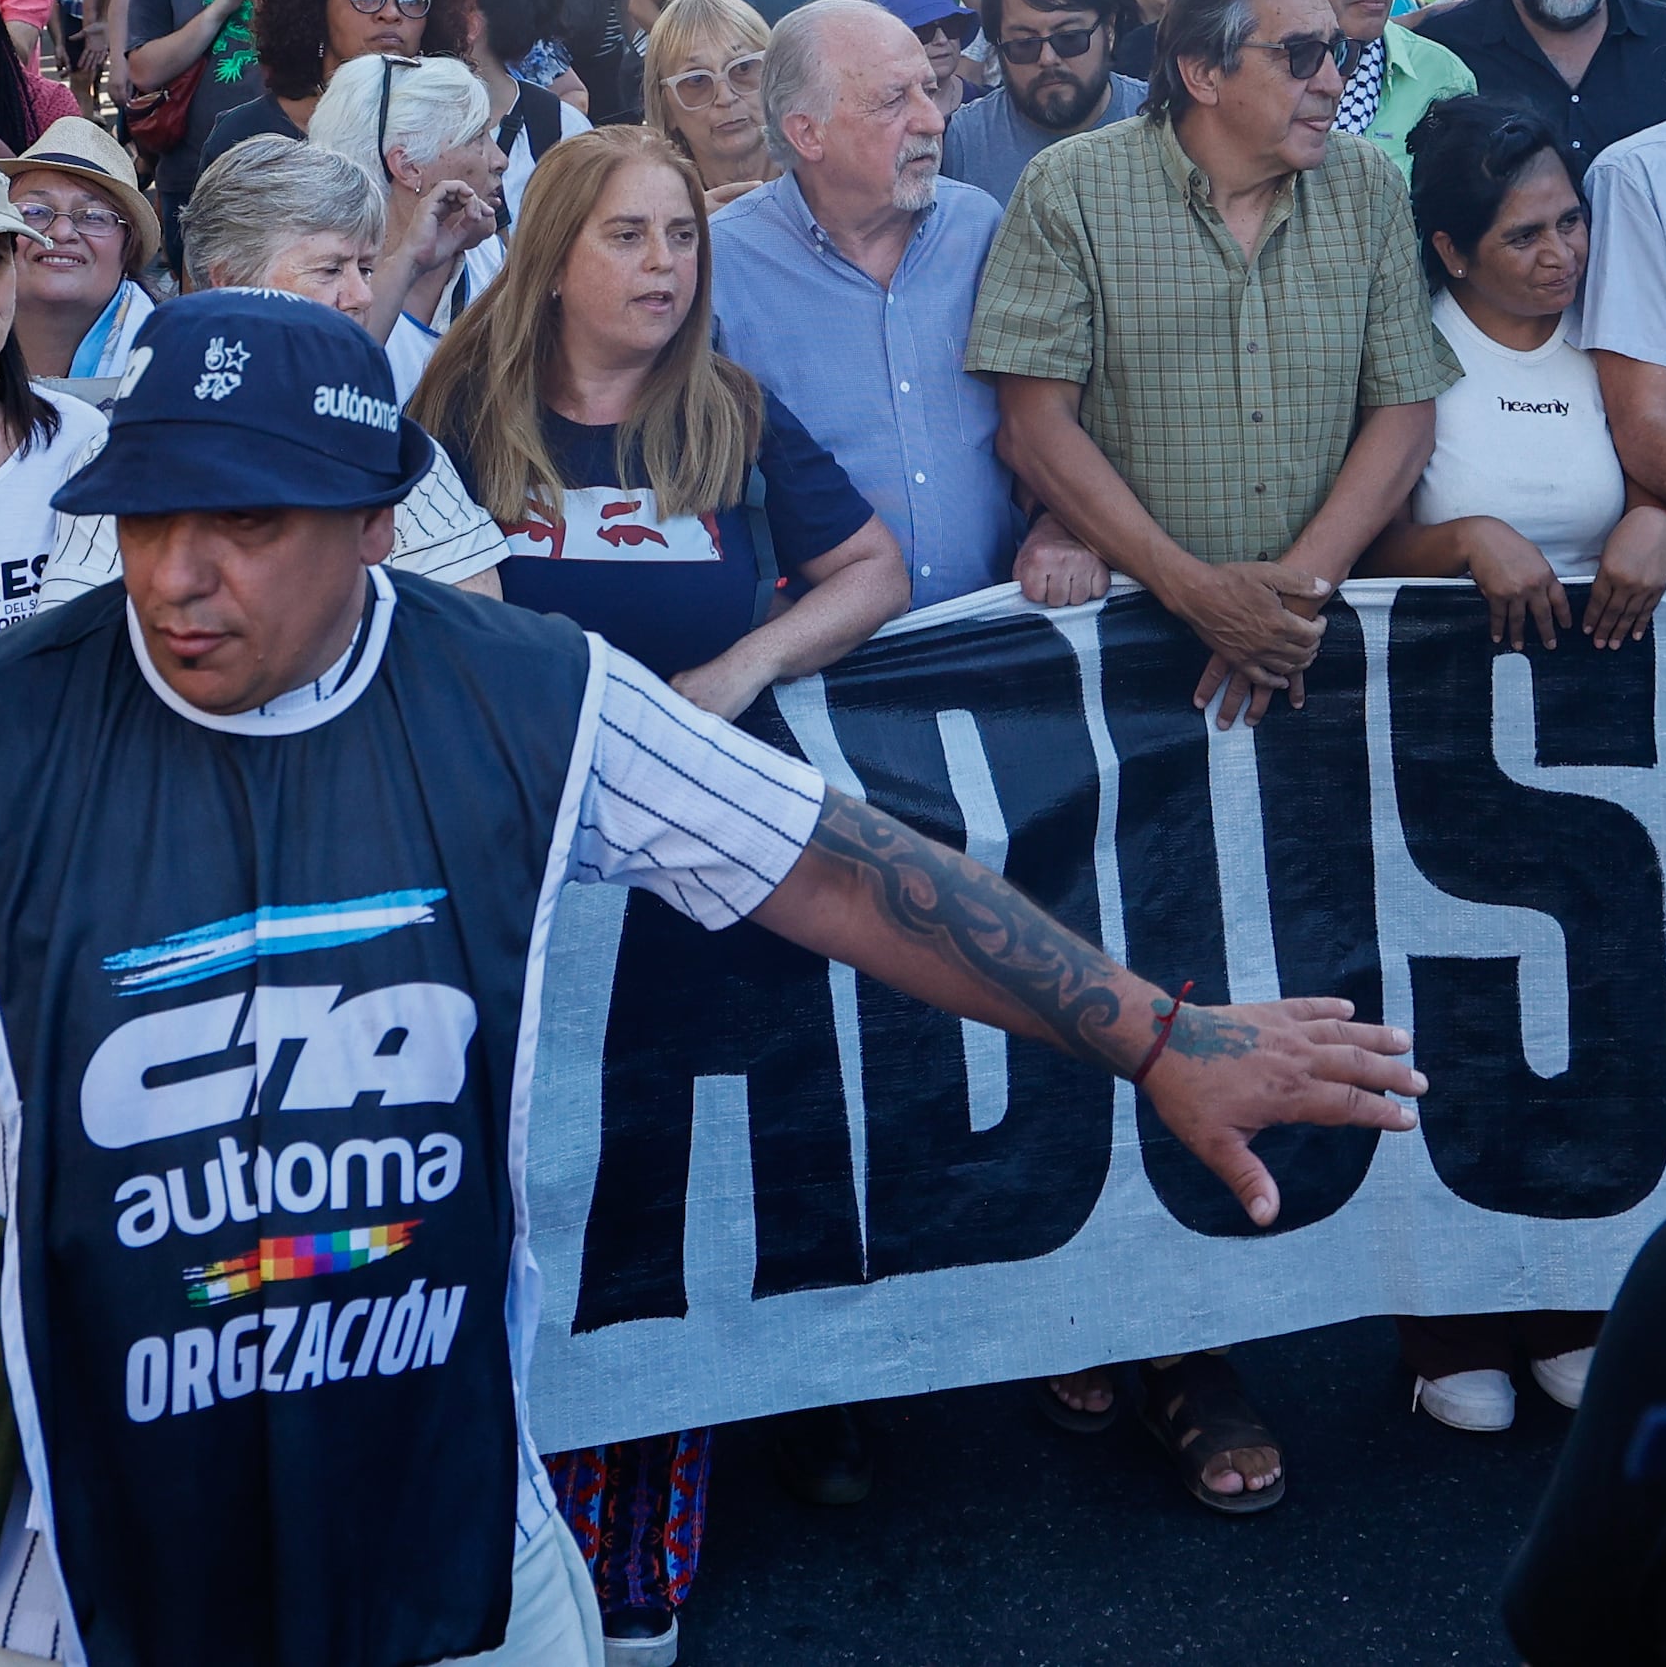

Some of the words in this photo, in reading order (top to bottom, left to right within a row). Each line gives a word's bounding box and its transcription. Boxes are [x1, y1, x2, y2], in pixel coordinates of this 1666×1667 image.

[314, 383, 399, 433] autónoma
[1495, 395, 1570, 417] heavenly
[5, 601, 28, 615] DEL
